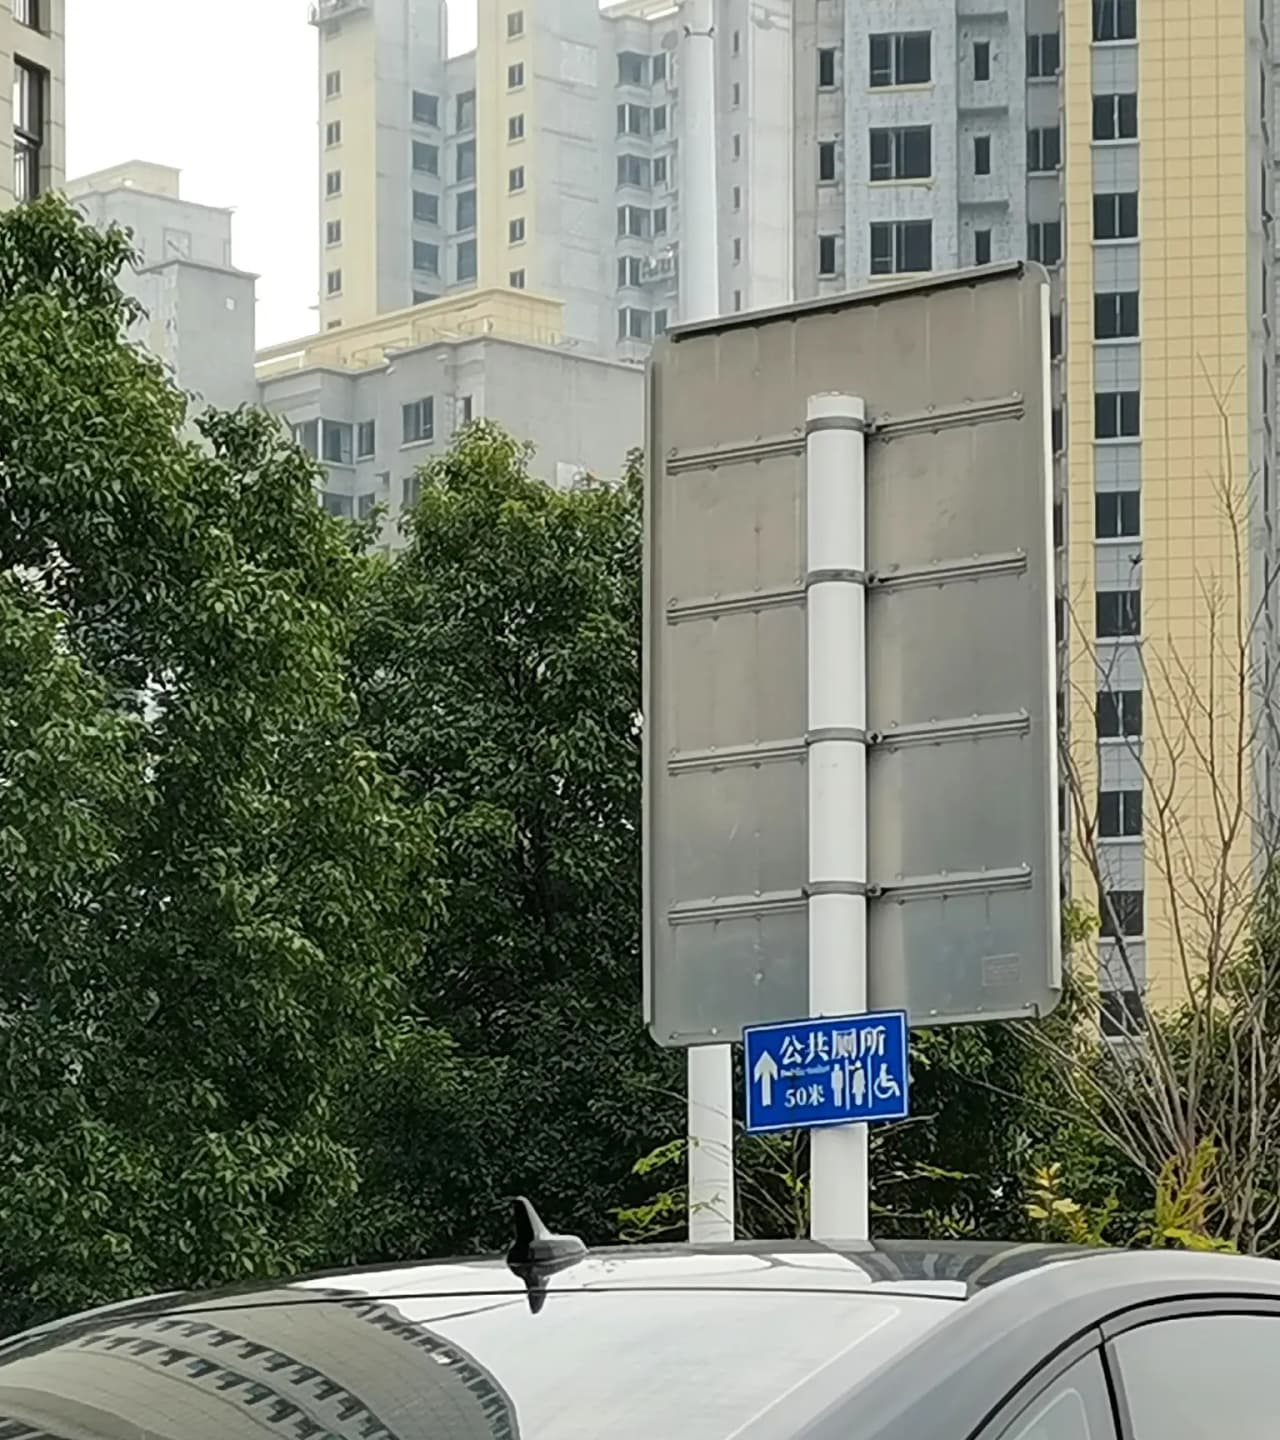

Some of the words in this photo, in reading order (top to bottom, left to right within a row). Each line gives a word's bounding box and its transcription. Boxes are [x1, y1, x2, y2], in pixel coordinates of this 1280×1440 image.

[780, 1025, 887, 1065] 公共厕所
[784, 1083, 825, 1108] 50米
